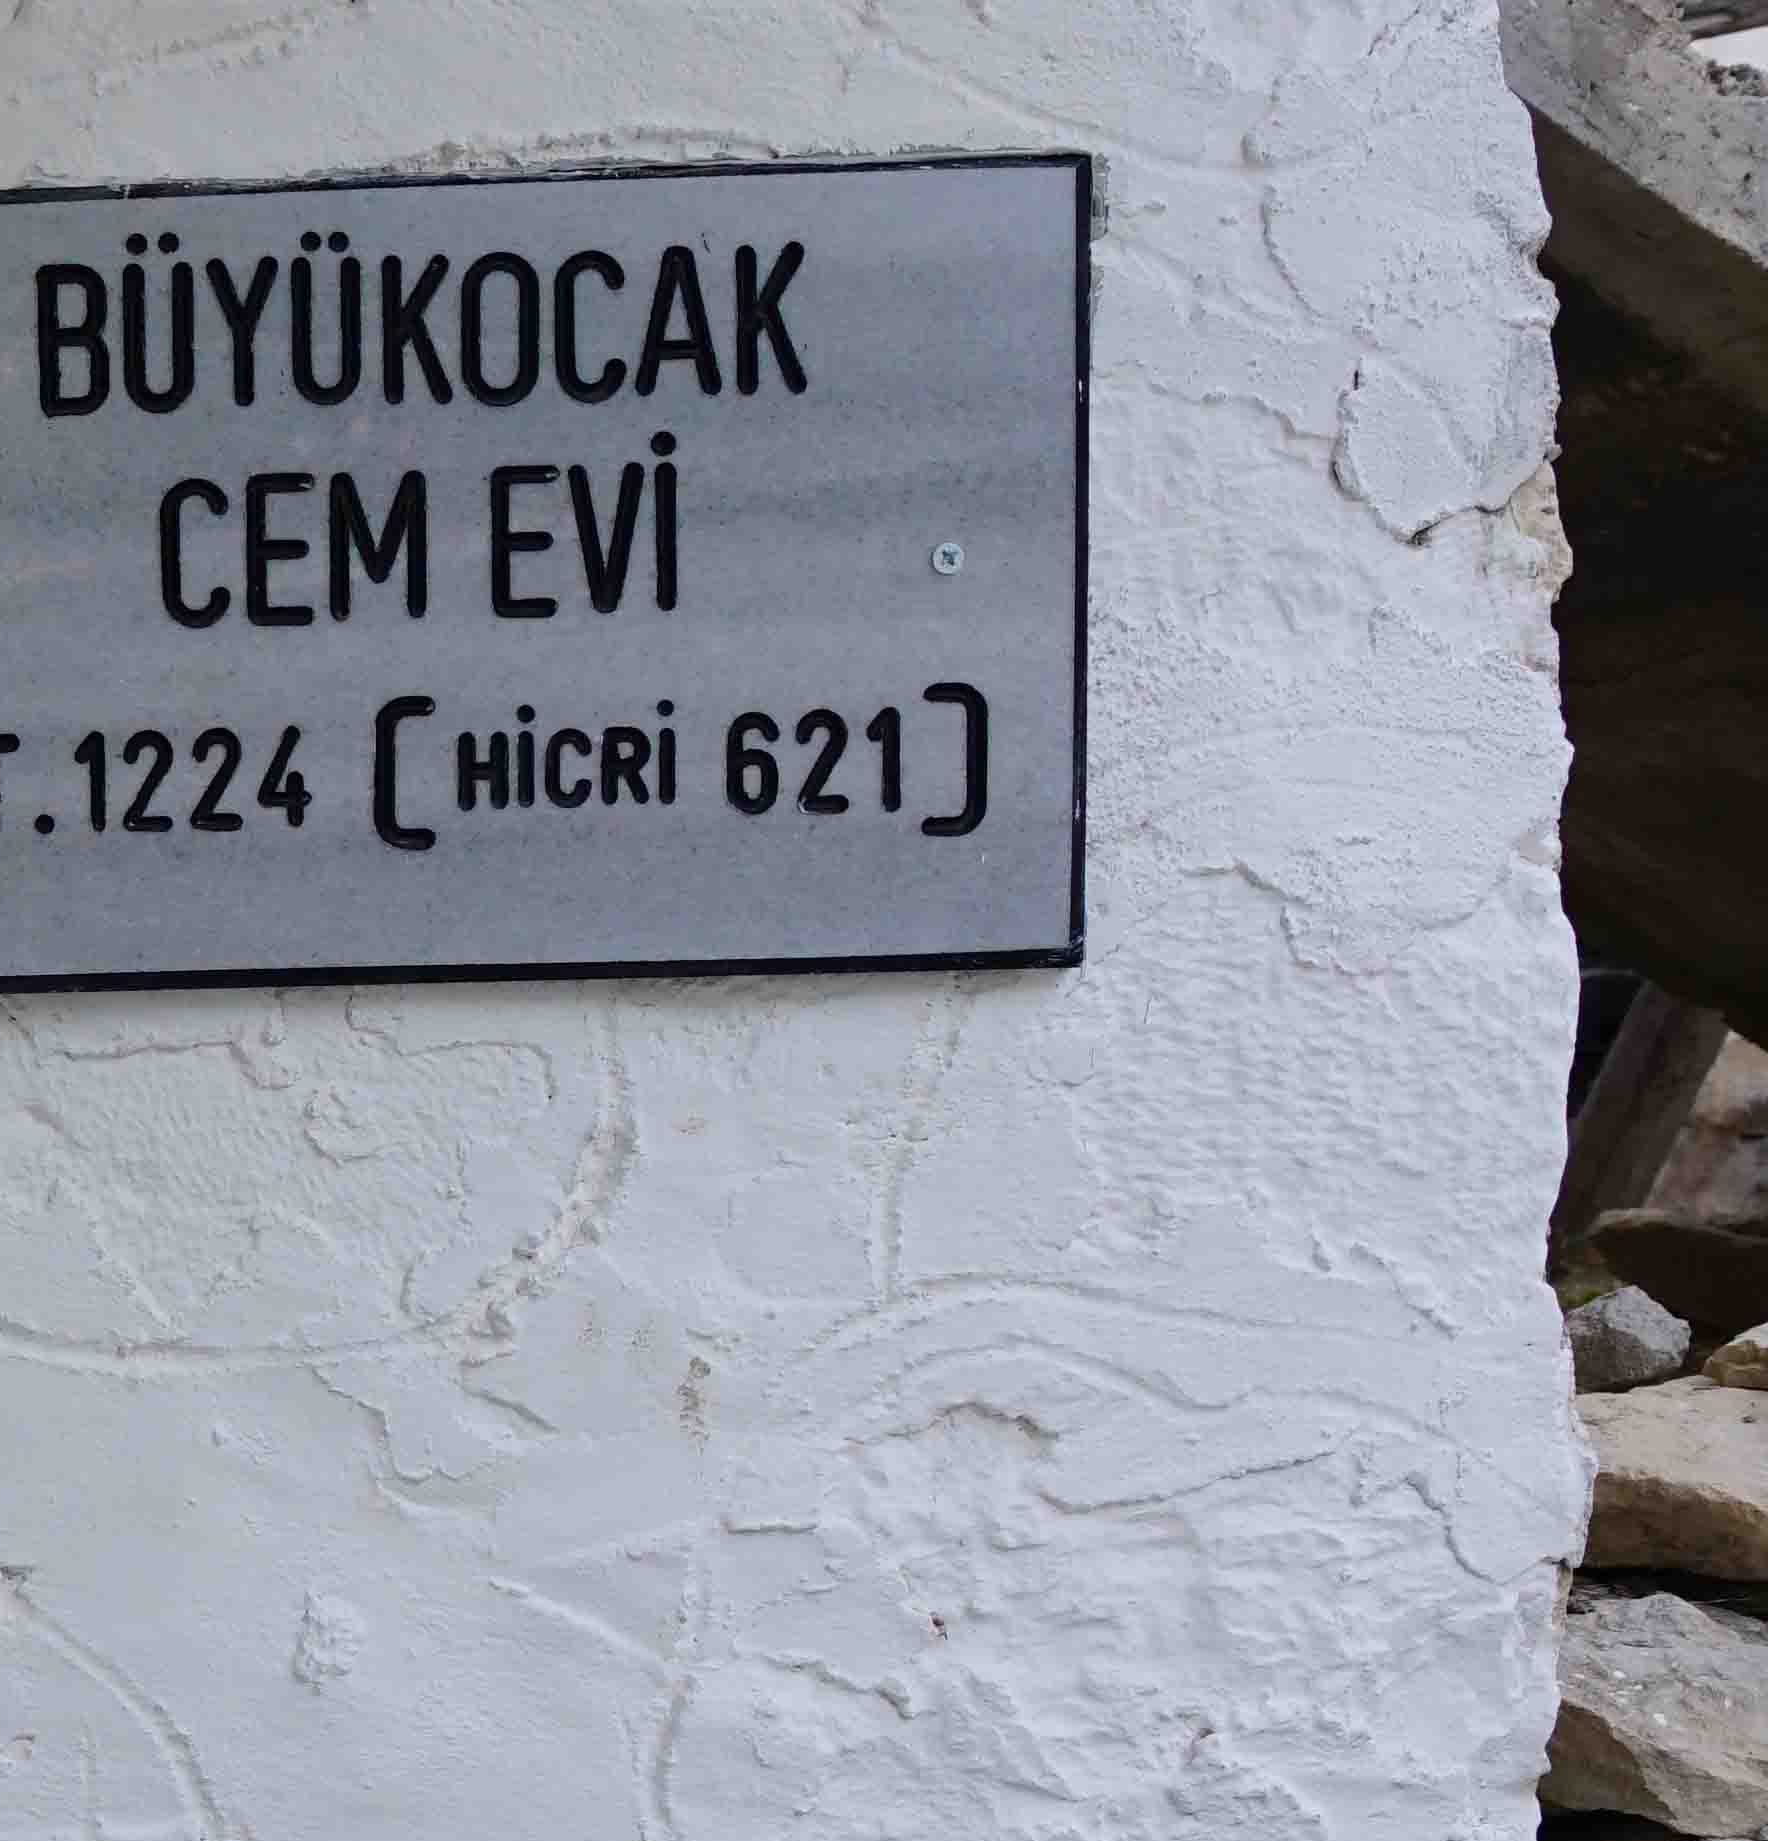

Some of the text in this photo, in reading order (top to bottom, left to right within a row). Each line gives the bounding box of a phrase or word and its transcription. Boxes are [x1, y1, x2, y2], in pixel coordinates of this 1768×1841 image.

[32, 230, 809, 421] BÜYÜKOCAK
[157, 429, 679, 630] CEM EVİ
